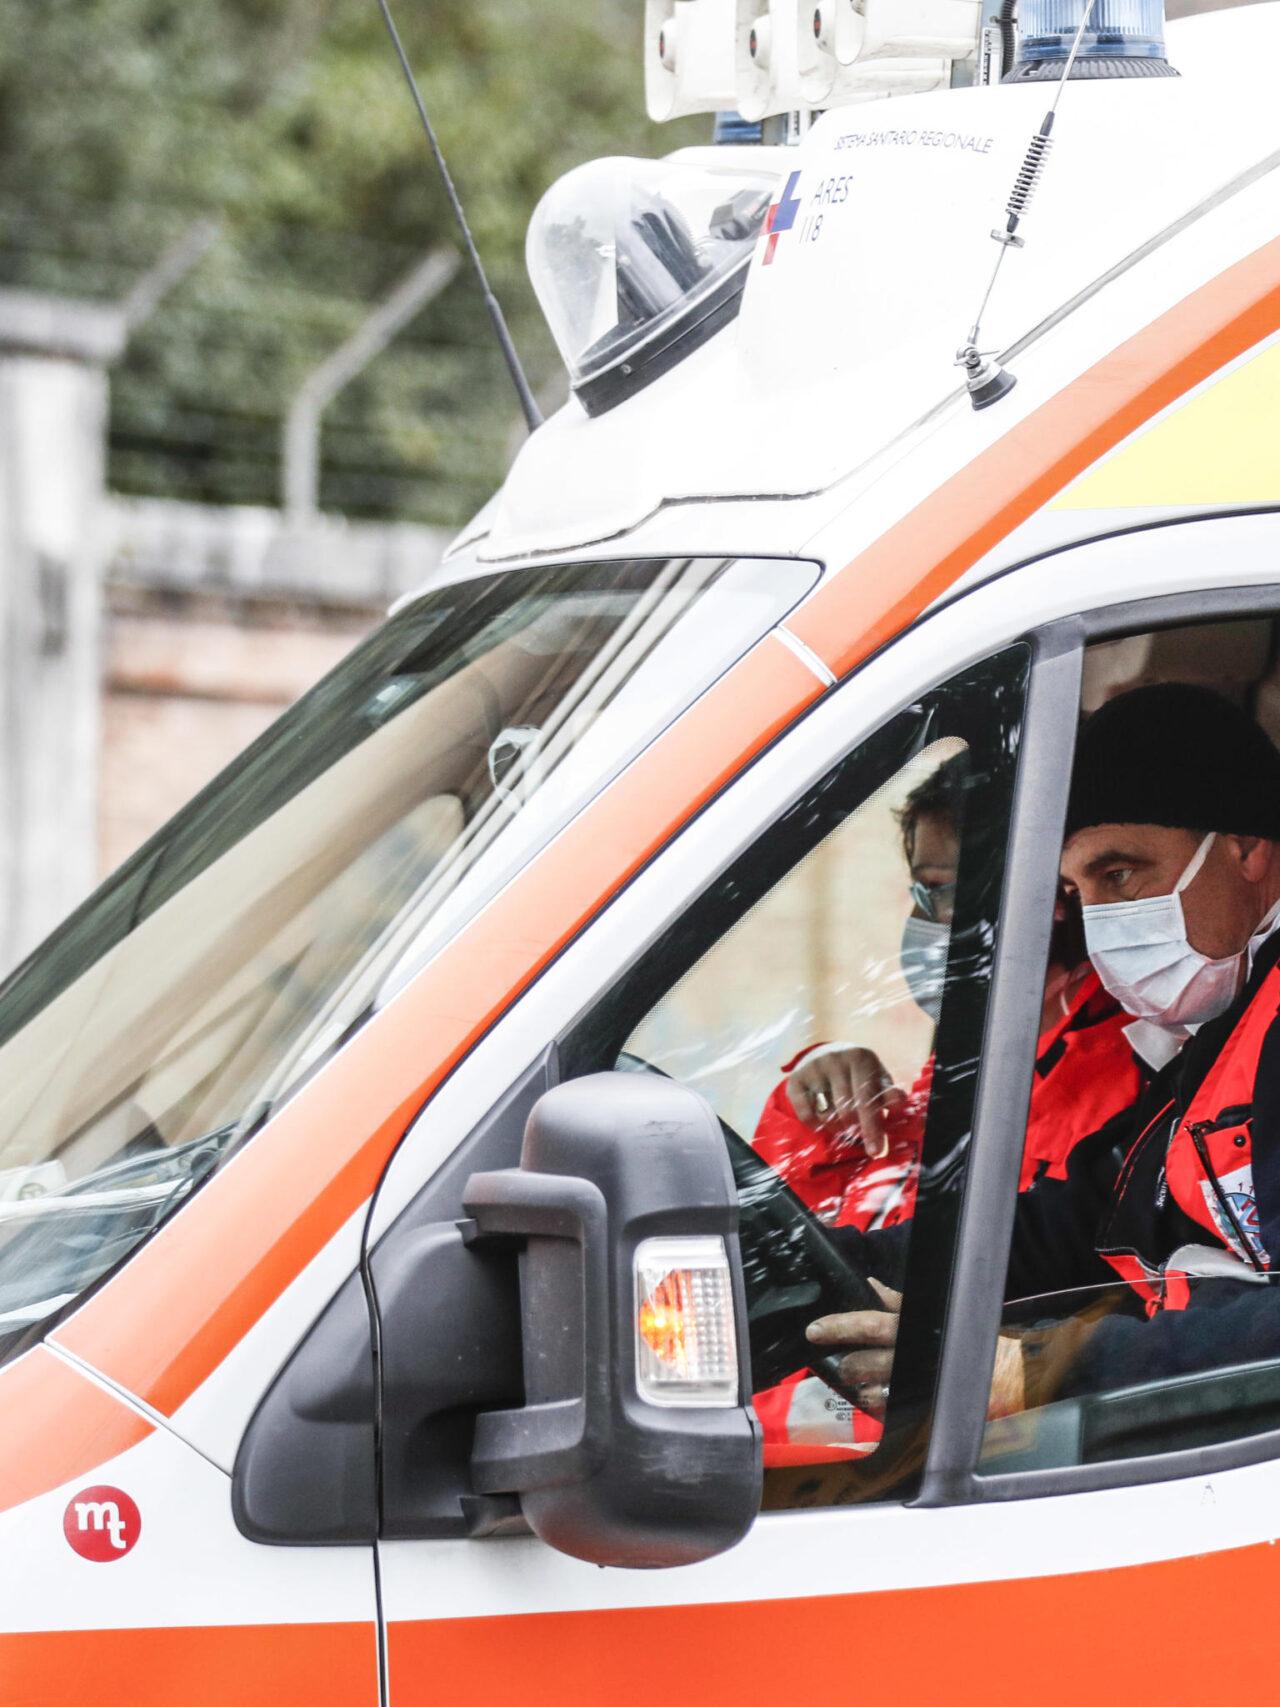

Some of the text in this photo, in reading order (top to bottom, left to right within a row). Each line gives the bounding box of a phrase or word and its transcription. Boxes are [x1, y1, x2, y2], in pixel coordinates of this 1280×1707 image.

[919, 130, 994, 154] REGIONALE
[811, 176, 854, 206] ARES
[799, 214, 824, 243] 118
[74, 1501, 127, 1549] mt
